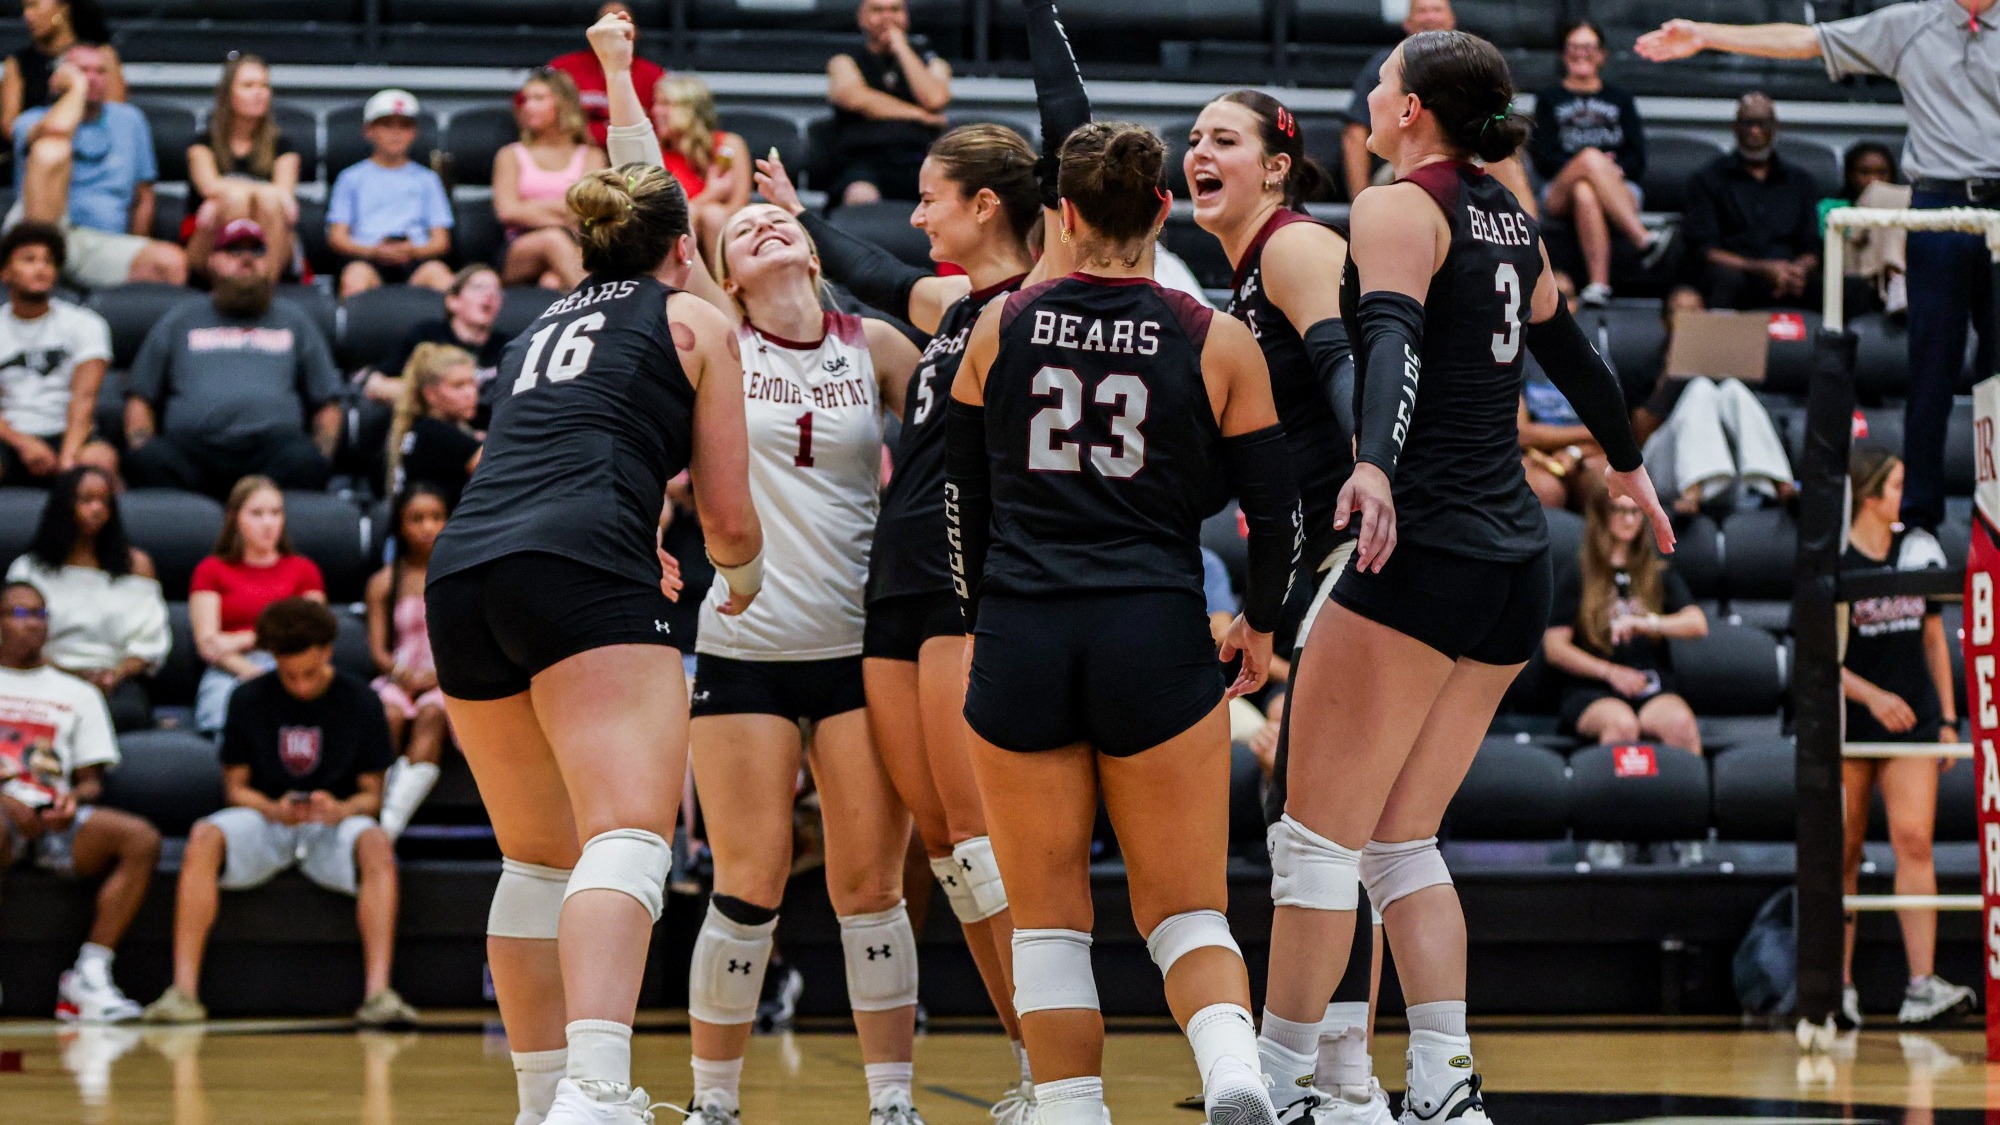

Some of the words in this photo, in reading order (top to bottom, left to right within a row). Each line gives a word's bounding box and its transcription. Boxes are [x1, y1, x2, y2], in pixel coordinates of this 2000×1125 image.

[1466, 205, 1531, 246] BEARS
[538, 280, 640, 319] BEARS
[1491, 262, 1521, 364] 3
[511, 311, 607, 396] 16
[1031, 310, 1160, 355] BEARS
[742, 369, 869, 409] ENOIR-RHYNE
[913, 363, 937, 425] 5
[794, 411, 815, 467] 1
[1028, 364, 1149, 480] 23
